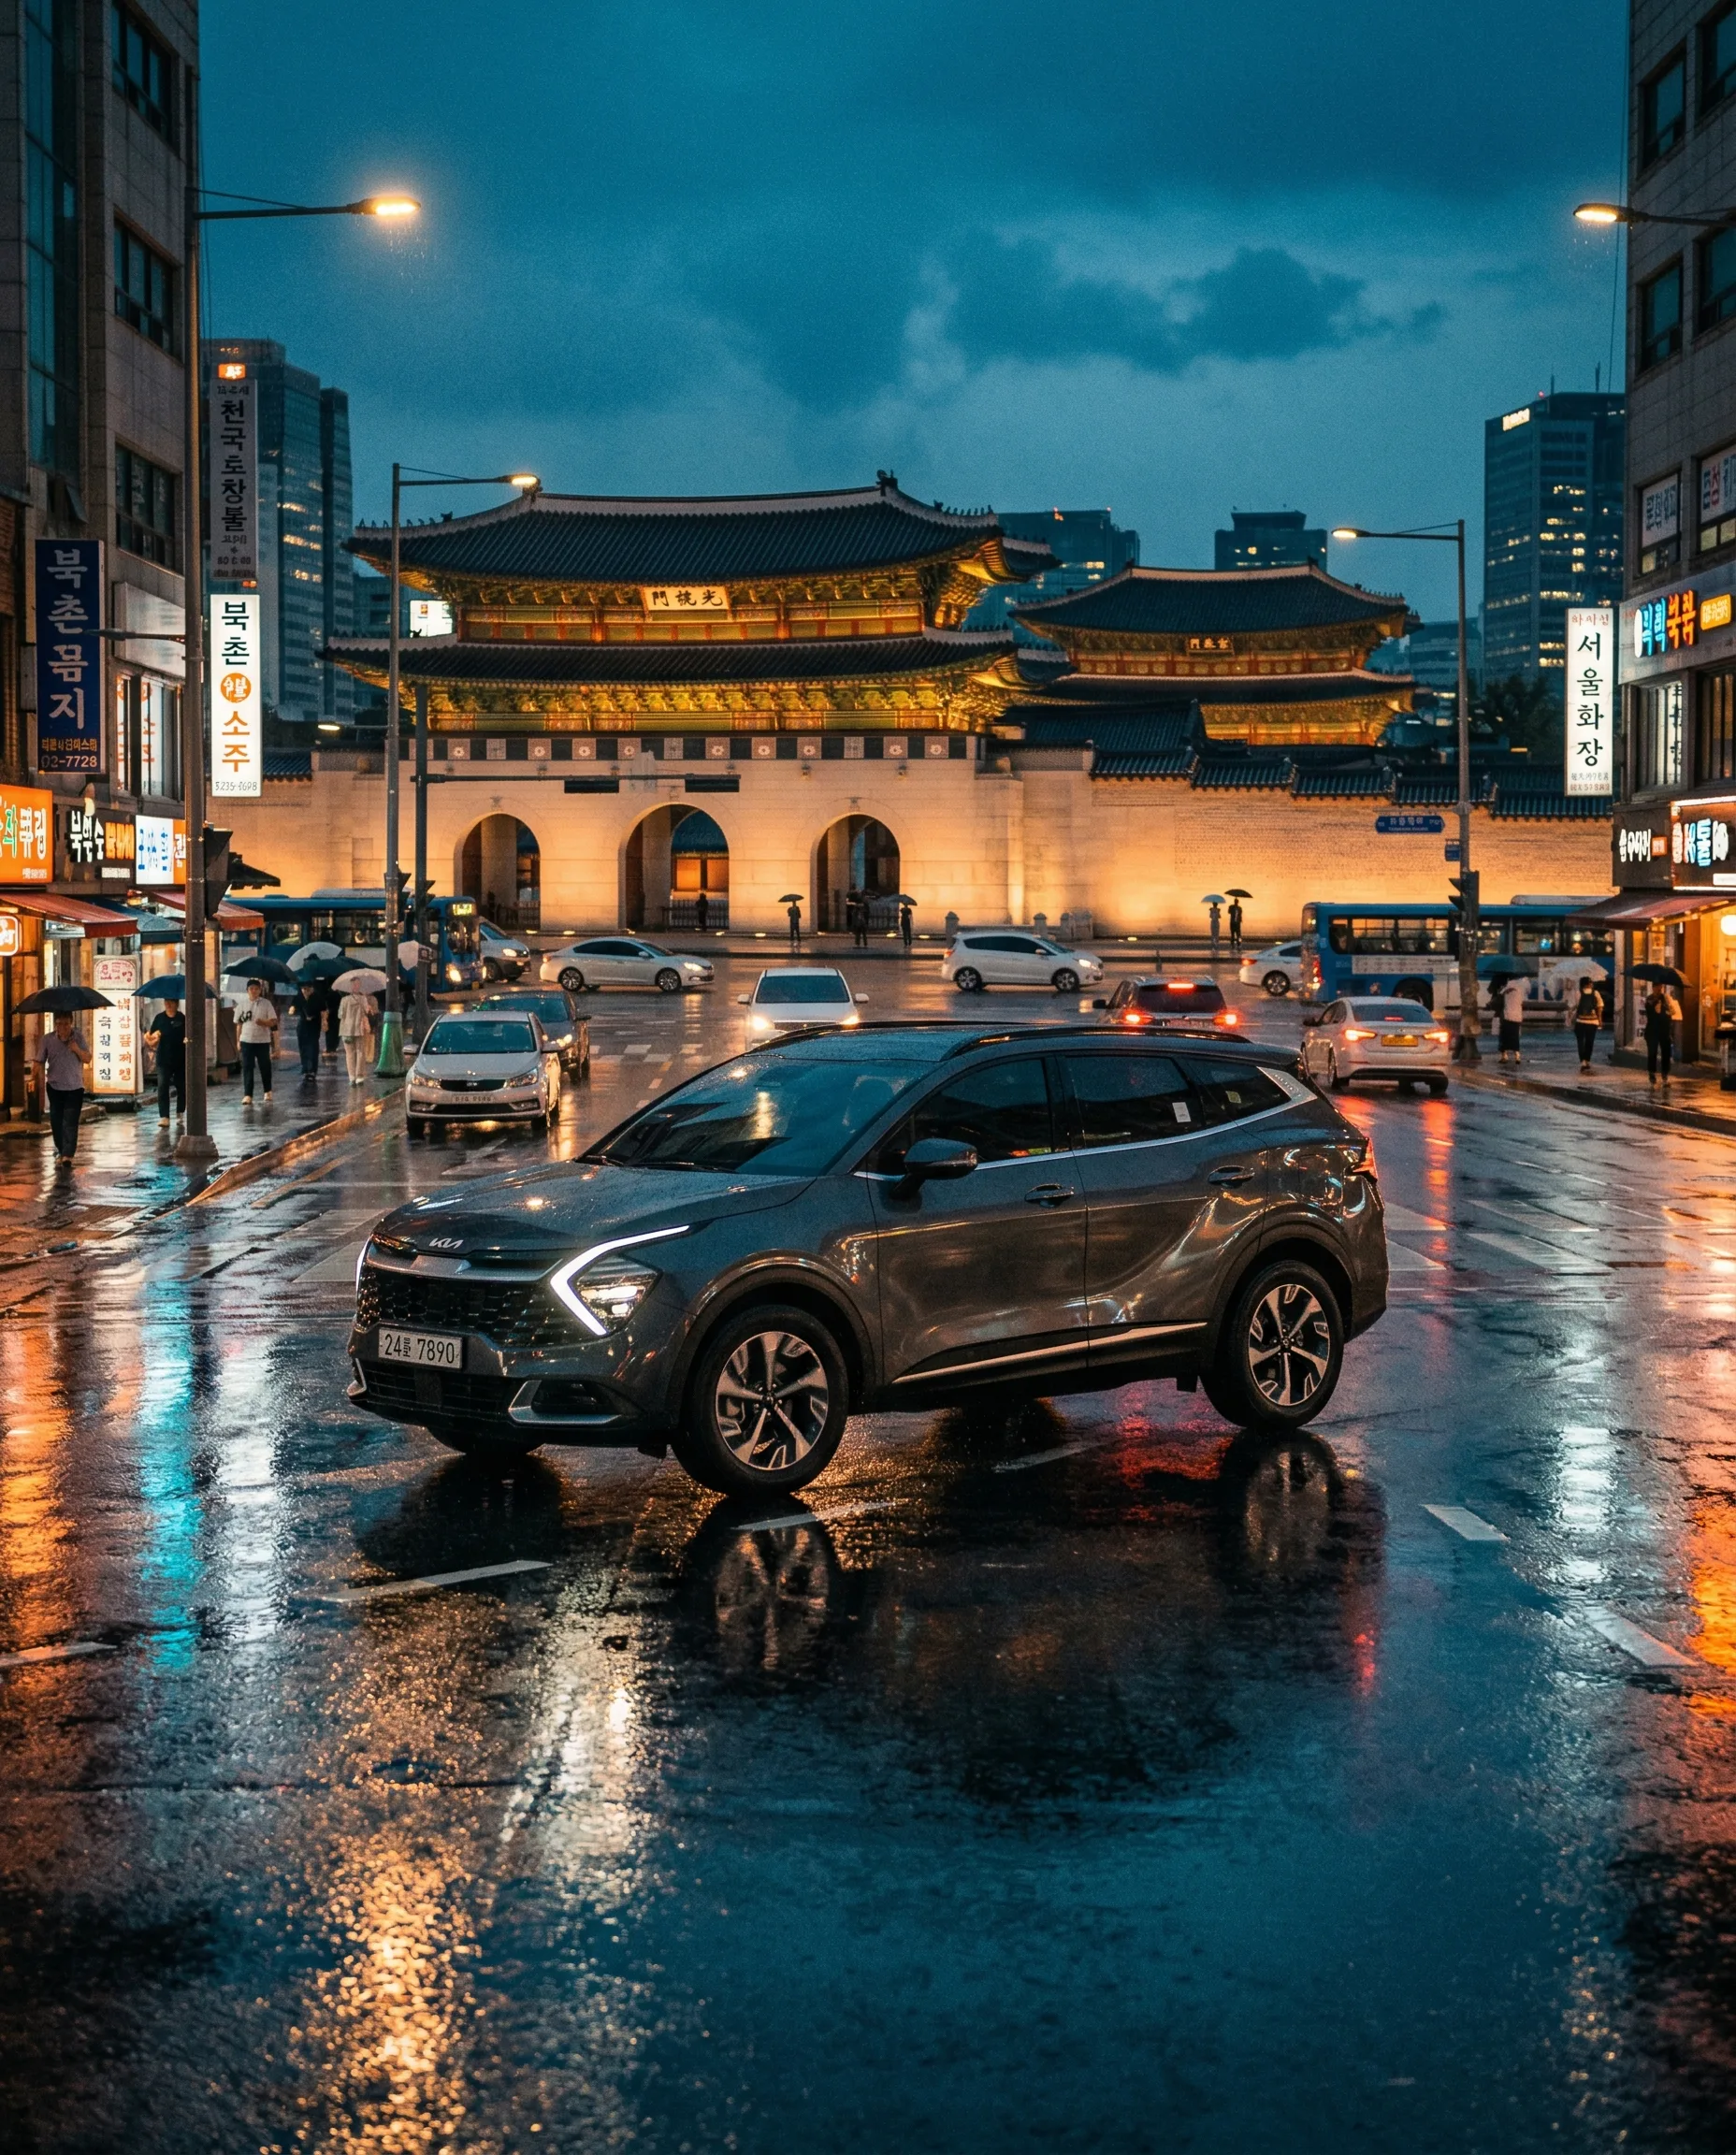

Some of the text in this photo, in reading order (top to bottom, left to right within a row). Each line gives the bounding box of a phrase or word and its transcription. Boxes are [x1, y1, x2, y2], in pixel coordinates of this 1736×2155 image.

[221, 601, 250, 666] 북촌
[1576, 632, 1605, 767] 서울화장
[41, 755, 97, 768] 02-7728
[221, 711, 251, 773] 소주
[417, 1338, 456, 1365] 7890
